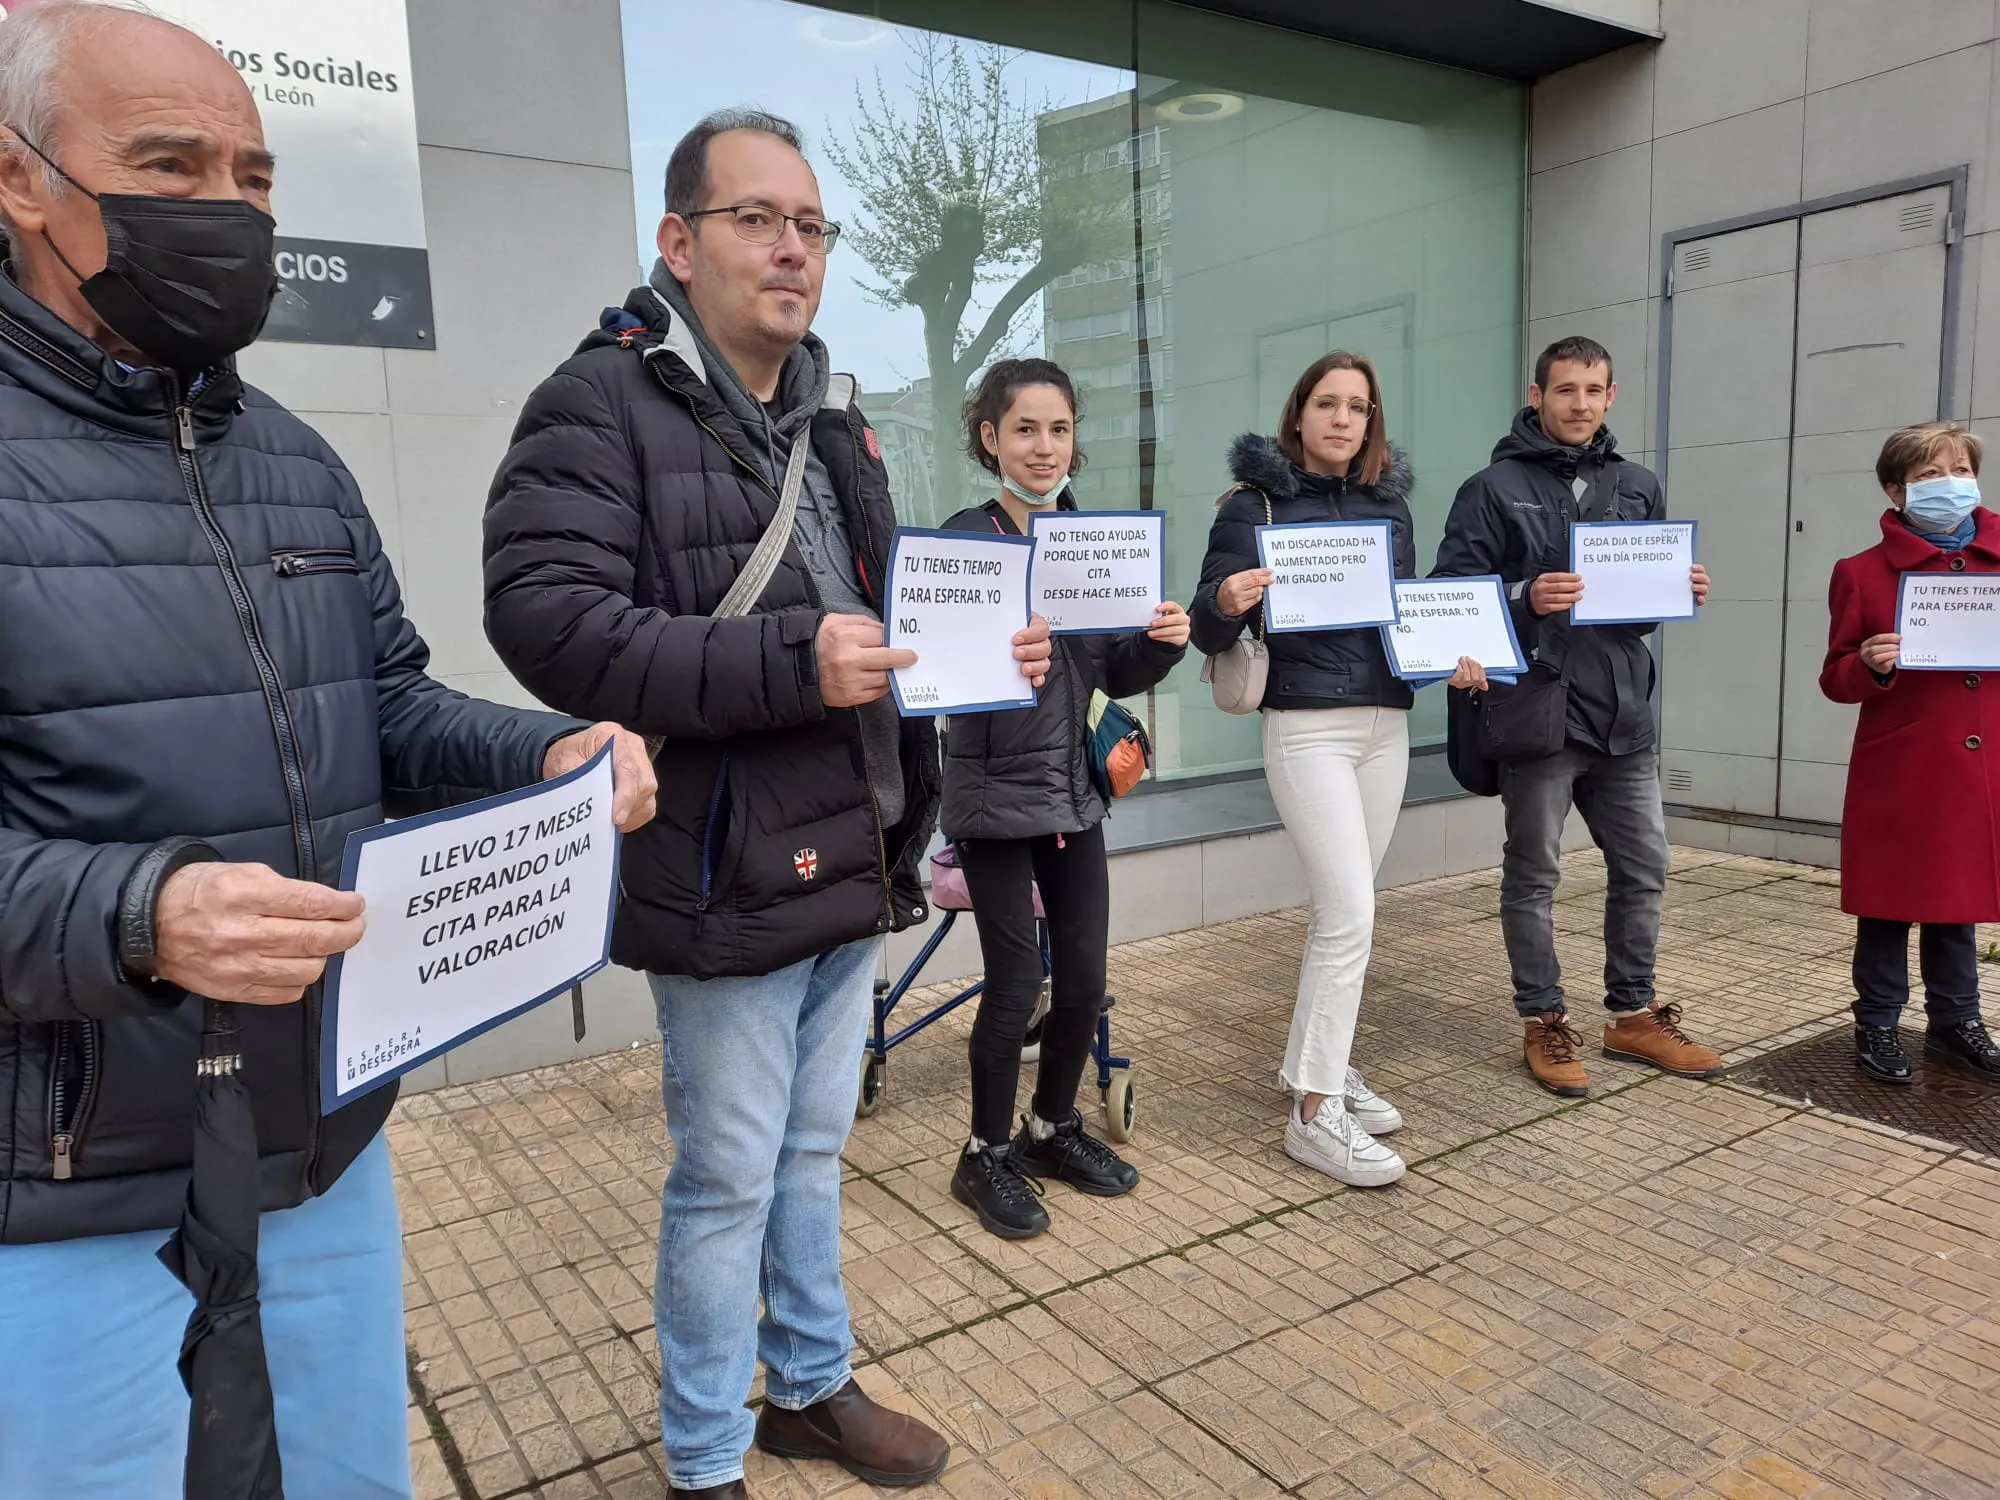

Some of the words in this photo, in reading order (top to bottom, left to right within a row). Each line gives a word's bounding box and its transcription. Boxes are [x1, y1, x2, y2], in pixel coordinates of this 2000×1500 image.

[274, 51, 398, 93] Sociales
[264, 83, 315, 107] León
[274, 251, 349, 283] CIOS
[1049, 531, 1066, 543] NO
[1069, 530, 1105, 542] TENGO
[1107, 529, 1147, 541] AYUDAS
[1583, 537, 1609, 547] CADA
[1630, 536, 1643, 546] DE
[1645, 535, 1679, 545] ESPERA
[1271, 541, 1285, 550] MI
[1288, 537, 1359, 549] DISCAPACIDAD
[1362, 537, 1376, 546] HA
[1043, 549, 1090, 562] PORQUE
[1092, 549, 1109, 560] NO
[1111, 549, 1127, 560] ME
[1129, 548, 1150, 559] DAN
[1274, 555, 1339, 567] AUMENTADO
[1341, 554, 1367, 564] PERO
[1583, 554, 1594, 563] ES
[1596, 554, 1611, 563] UN
[1613, 551, 1630, 562] DÍA
[1632, 552, 1673, 561] PERDIDO
[904, 556, 920, 572] TU
[923, 557, 960, 574] TIENES
[963, 559, 1002, 576] TIEMPO
[1087, 568, 1111, 579] CITA
[1276, 575, 1289, 585] MI
[1291, 573, 1327, 584] GRADO
[1329, 572, 1344, 582] NO
[900, 587, 931, 603] PARA
[935, 588, 984, 604] ESPERAR.
[987, 589, 1001, 604] YO
[1043, 588, 1080, 600] DESDE
[1082, 588, 1111, 599] HACE
[1114, 586, 1147, 598] MESES
[1403, 593, 1436, 602] TIENES
[1437, 592, 1474, 602] TIEMPO
[1913, 586, 1928, 595] TU
[1931, 586, 1969, 595] TIENES
[1421, 608, 1464, 617] ESPERAR.
[1465, 607, 1479, 616] YO
[1910, 602, 1941, 611] PARA
[1944, 602, 1996, 611] ESPERAR.
[899, 618, 921, 633] NO.
[1396, 624, 1415, 633] NO.
[1909, 617, 1930, 627] NO.
[420, 836, 496, 877] LLEVO
[503, 825, 530, 851] 17
[535, 797, 592, 840] MESES
[406, 853, 548, 918] ESPERANDO
[555, 833, 591, 866] UNA
[423, 913, 476, 947] CITA
[484, 889, 543, 927] PARA
[550, 877, 571, 902] LA
[418, 911, 565, 985] VALORACIÓN
[360, 1037, 420, 1075] DESESPERA
